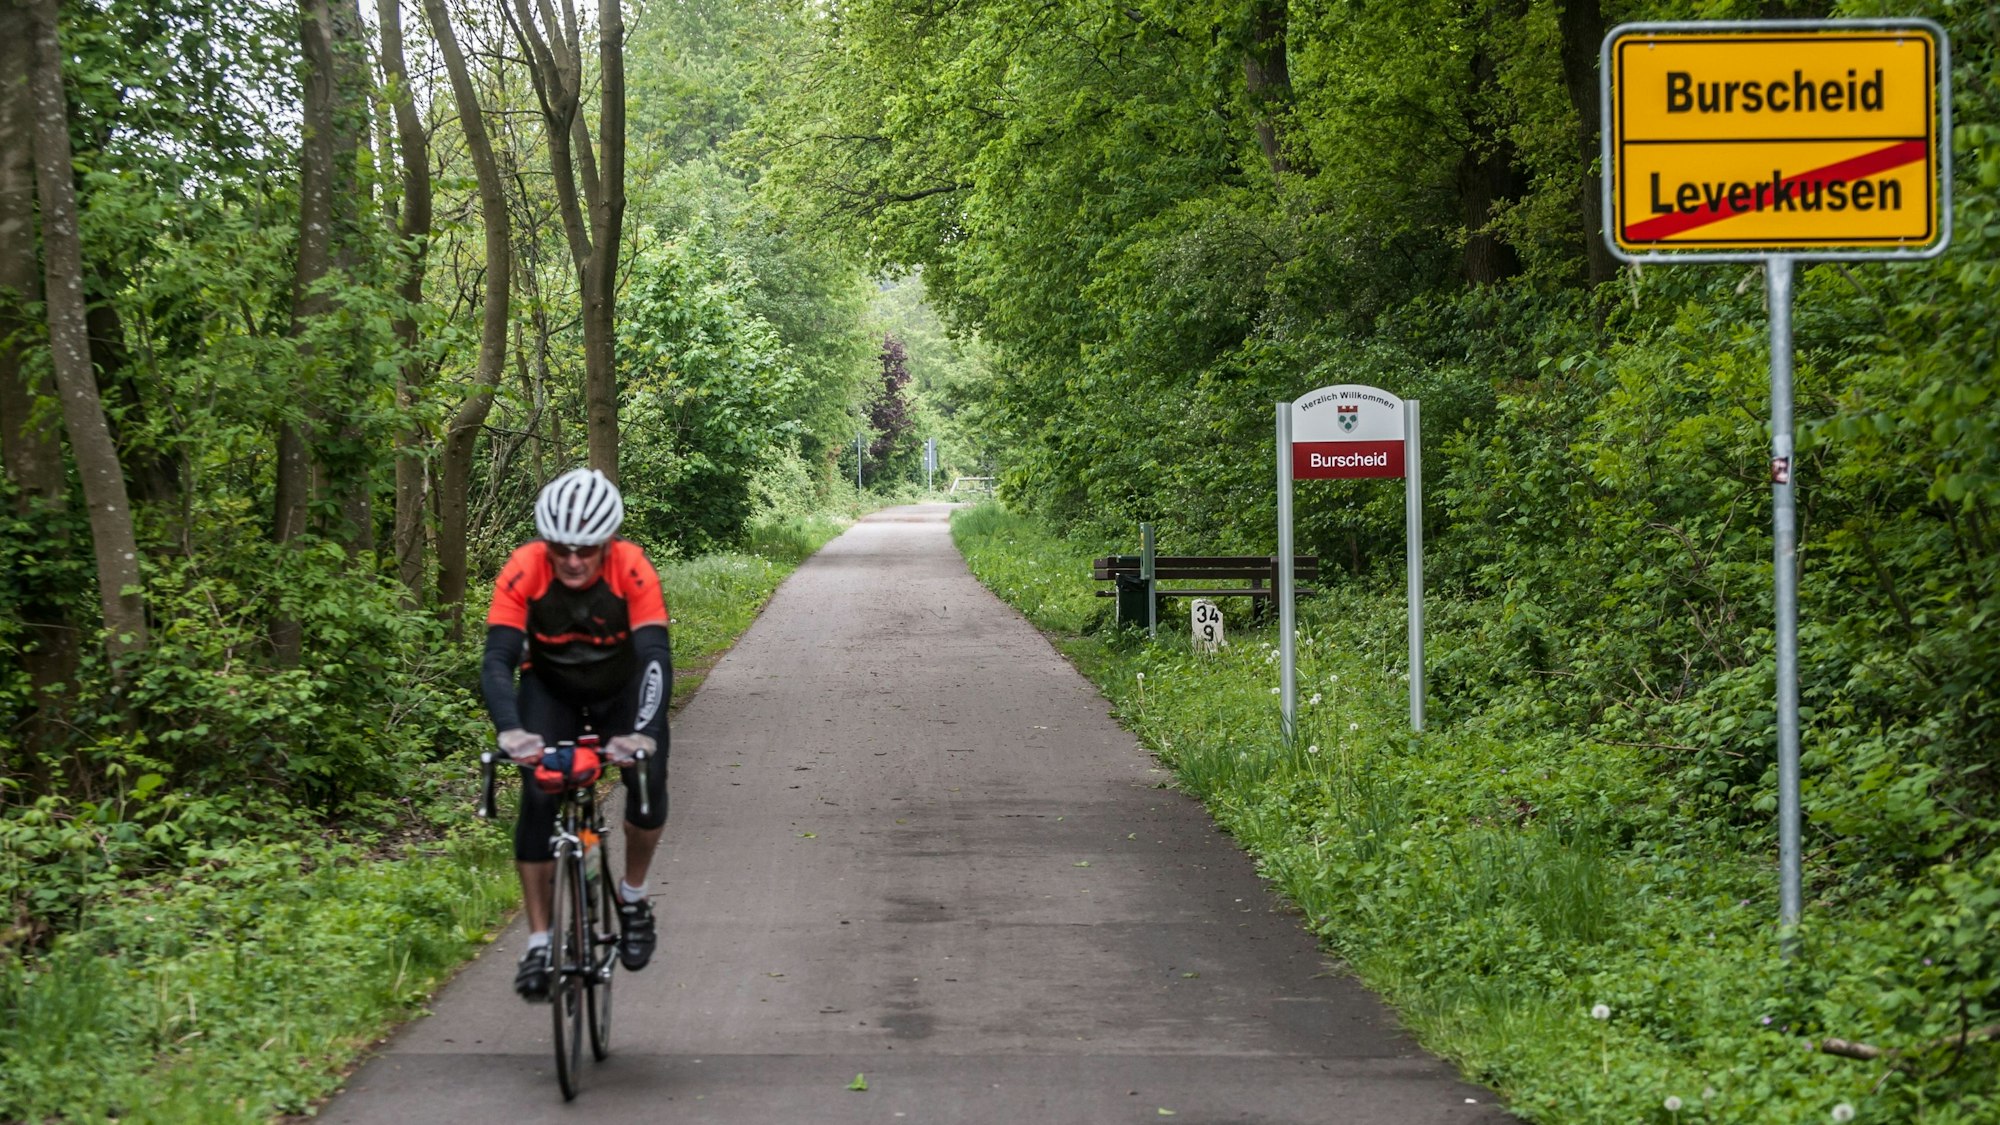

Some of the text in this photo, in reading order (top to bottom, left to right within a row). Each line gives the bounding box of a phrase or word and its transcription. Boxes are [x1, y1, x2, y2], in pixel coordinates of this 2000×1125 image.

[1666, 69, 1884, 114] Burscheid
[1650, 170, 1902, 215] Leverkusen
[1301, 391, 1395, 412] Herzlich Willkommen
[1311, 452, 1387, 467] Burscheid
[1197, 605, 1219, 623] 34
[1204, 625, 1214, 641] 9
